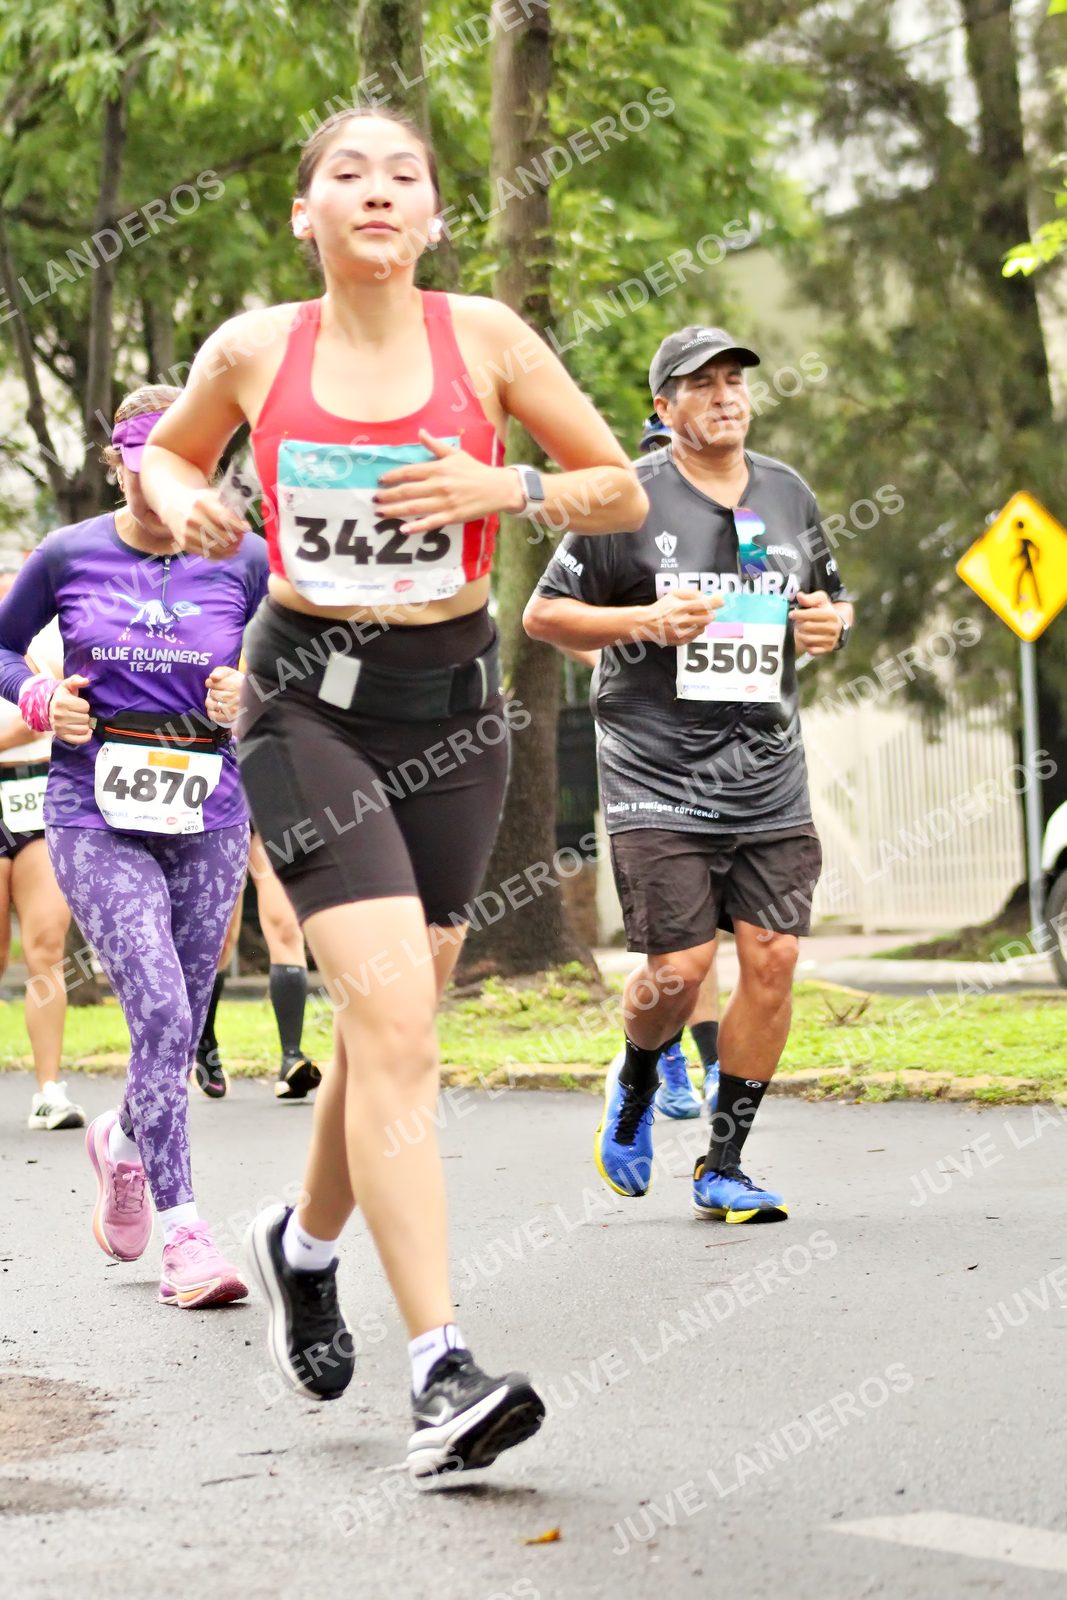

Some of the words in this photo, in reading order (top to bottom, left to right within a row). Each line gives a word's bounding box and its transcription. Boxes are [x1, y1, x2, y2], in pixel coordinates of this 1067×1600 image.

[295, 515, 451, 565] 3423
[91, 646, 131, 660] BLUE
[132, 647, 213, 666] RUNNERS
[129, 661, 172, 674] TEAM
[684, 642, 779, 675] 5505
[103, 765, 208, 809] 4870
[674, 805, 719, 818] corriendo
